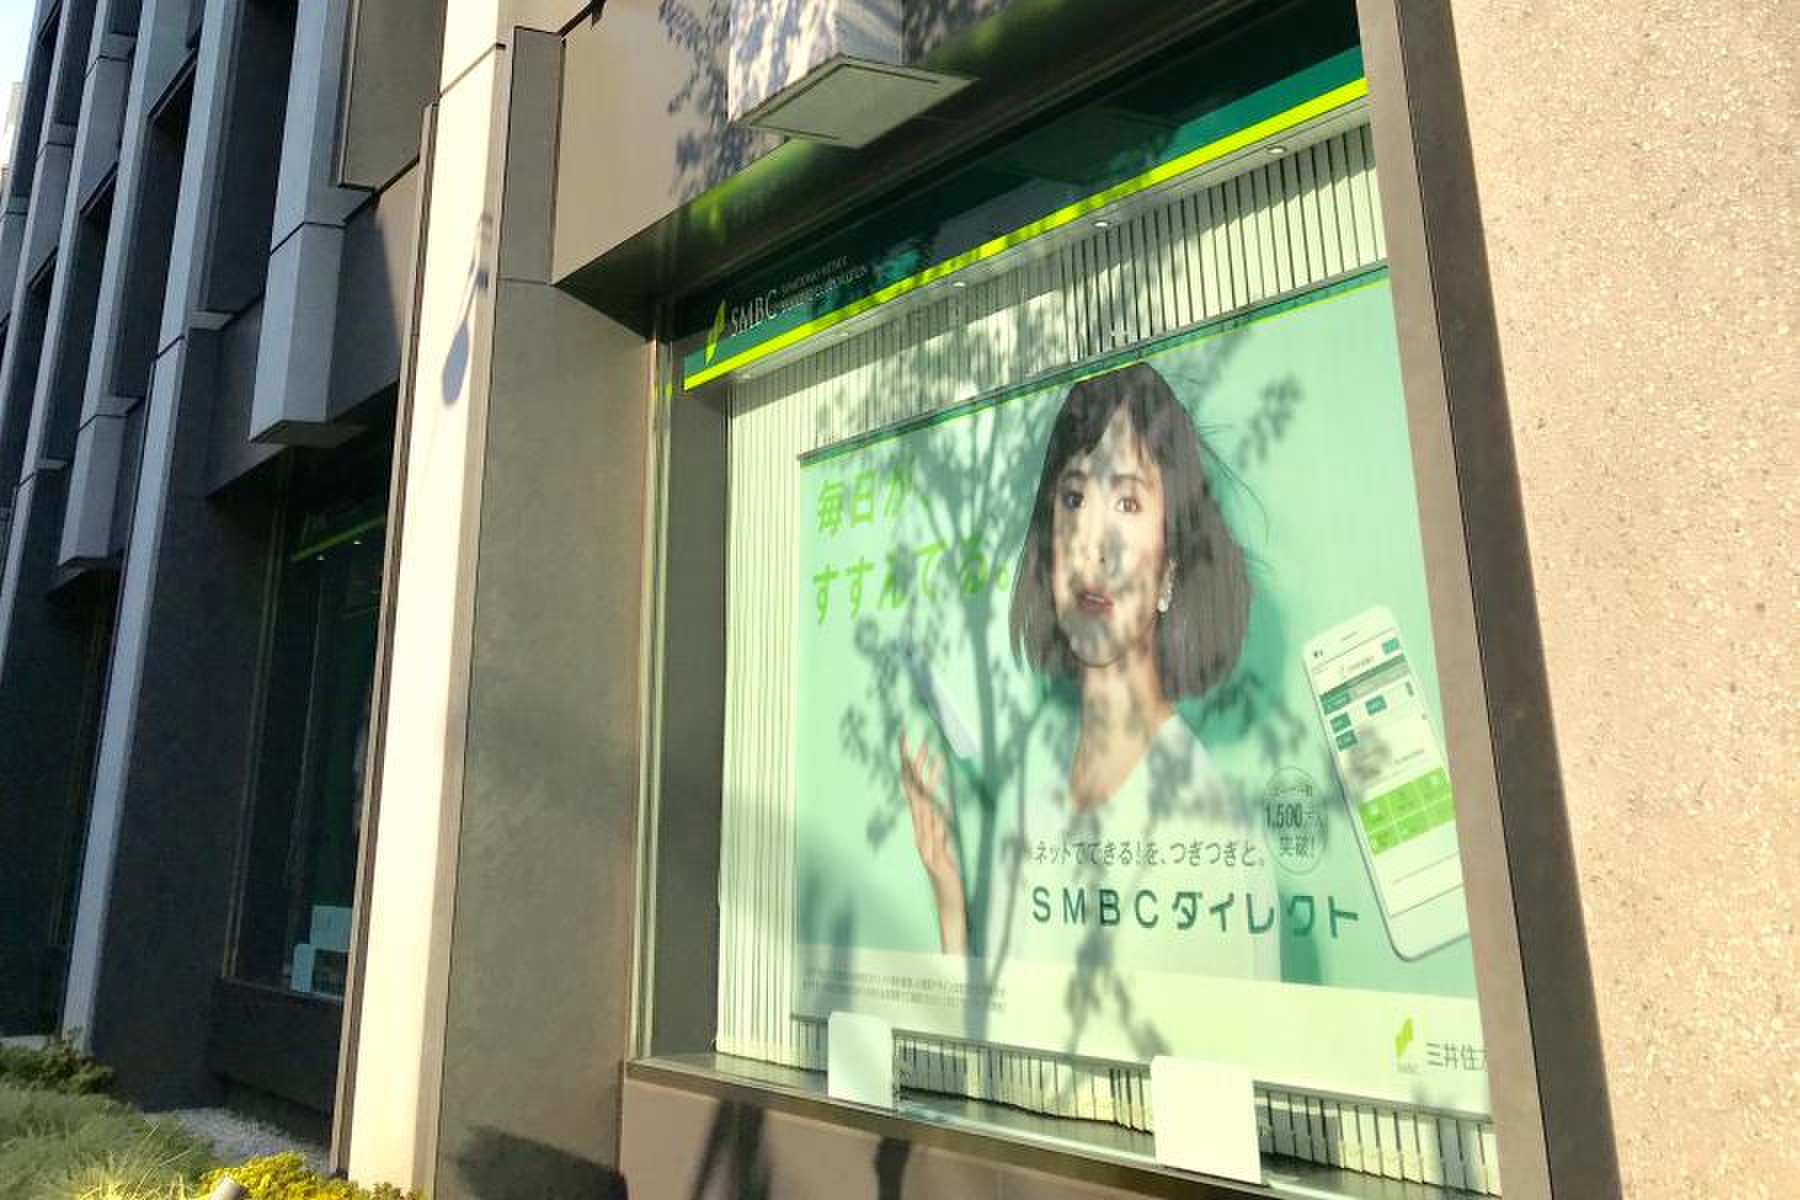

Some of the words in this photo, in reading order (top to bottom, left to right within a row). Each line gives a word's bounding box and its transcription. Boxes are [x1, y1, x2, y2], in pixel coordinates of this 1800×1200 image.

[730, 288, 777, 337] SMBC
[1425, 1040, 1488, 1071] 三井住
